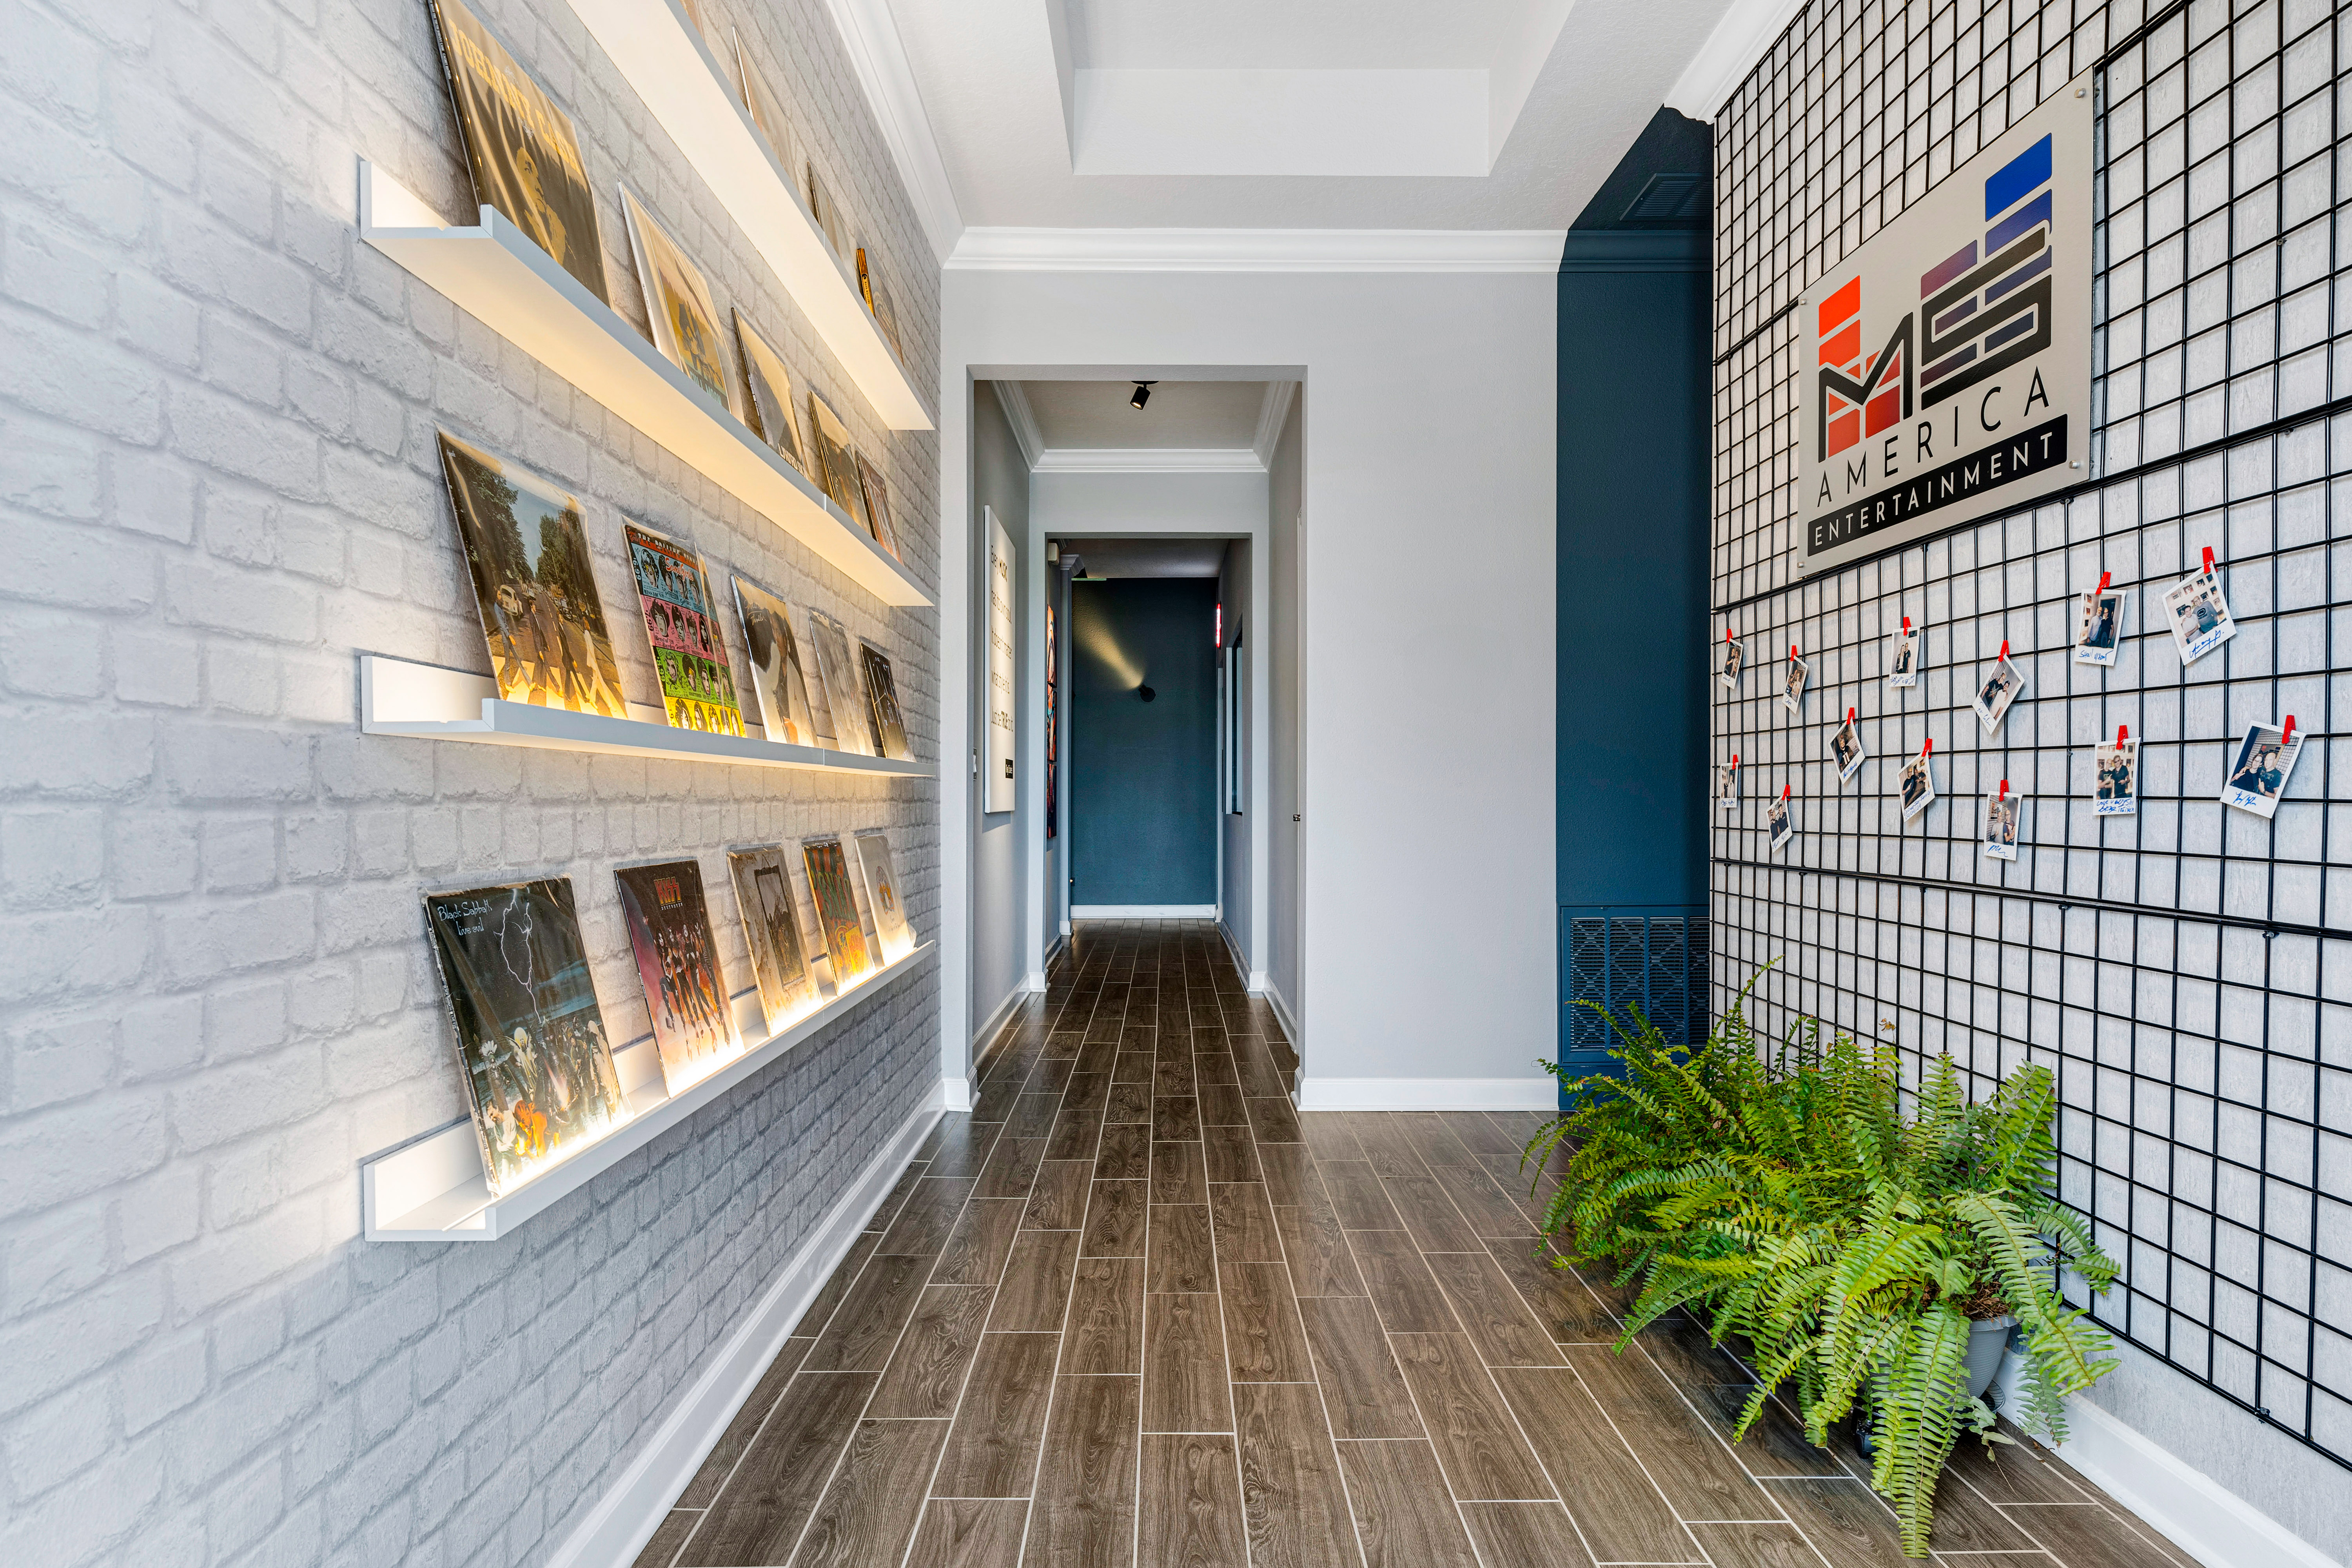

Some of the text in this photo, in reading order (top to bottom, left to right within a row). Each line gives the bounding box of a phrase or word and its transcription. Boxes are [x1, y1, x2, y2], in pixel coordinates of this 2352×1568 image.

[448, 18, 582, 176] JOHNNY CASH
[1817, 365, 2050, 508] AMERICA
[1815, 433, 2053, 545] ENTERTAINMENT
[437, 898, 492, 922] Black Sabbath
[653, 876, 682, 906] KISS
[661, 902, 683, 911] DESTROYER
